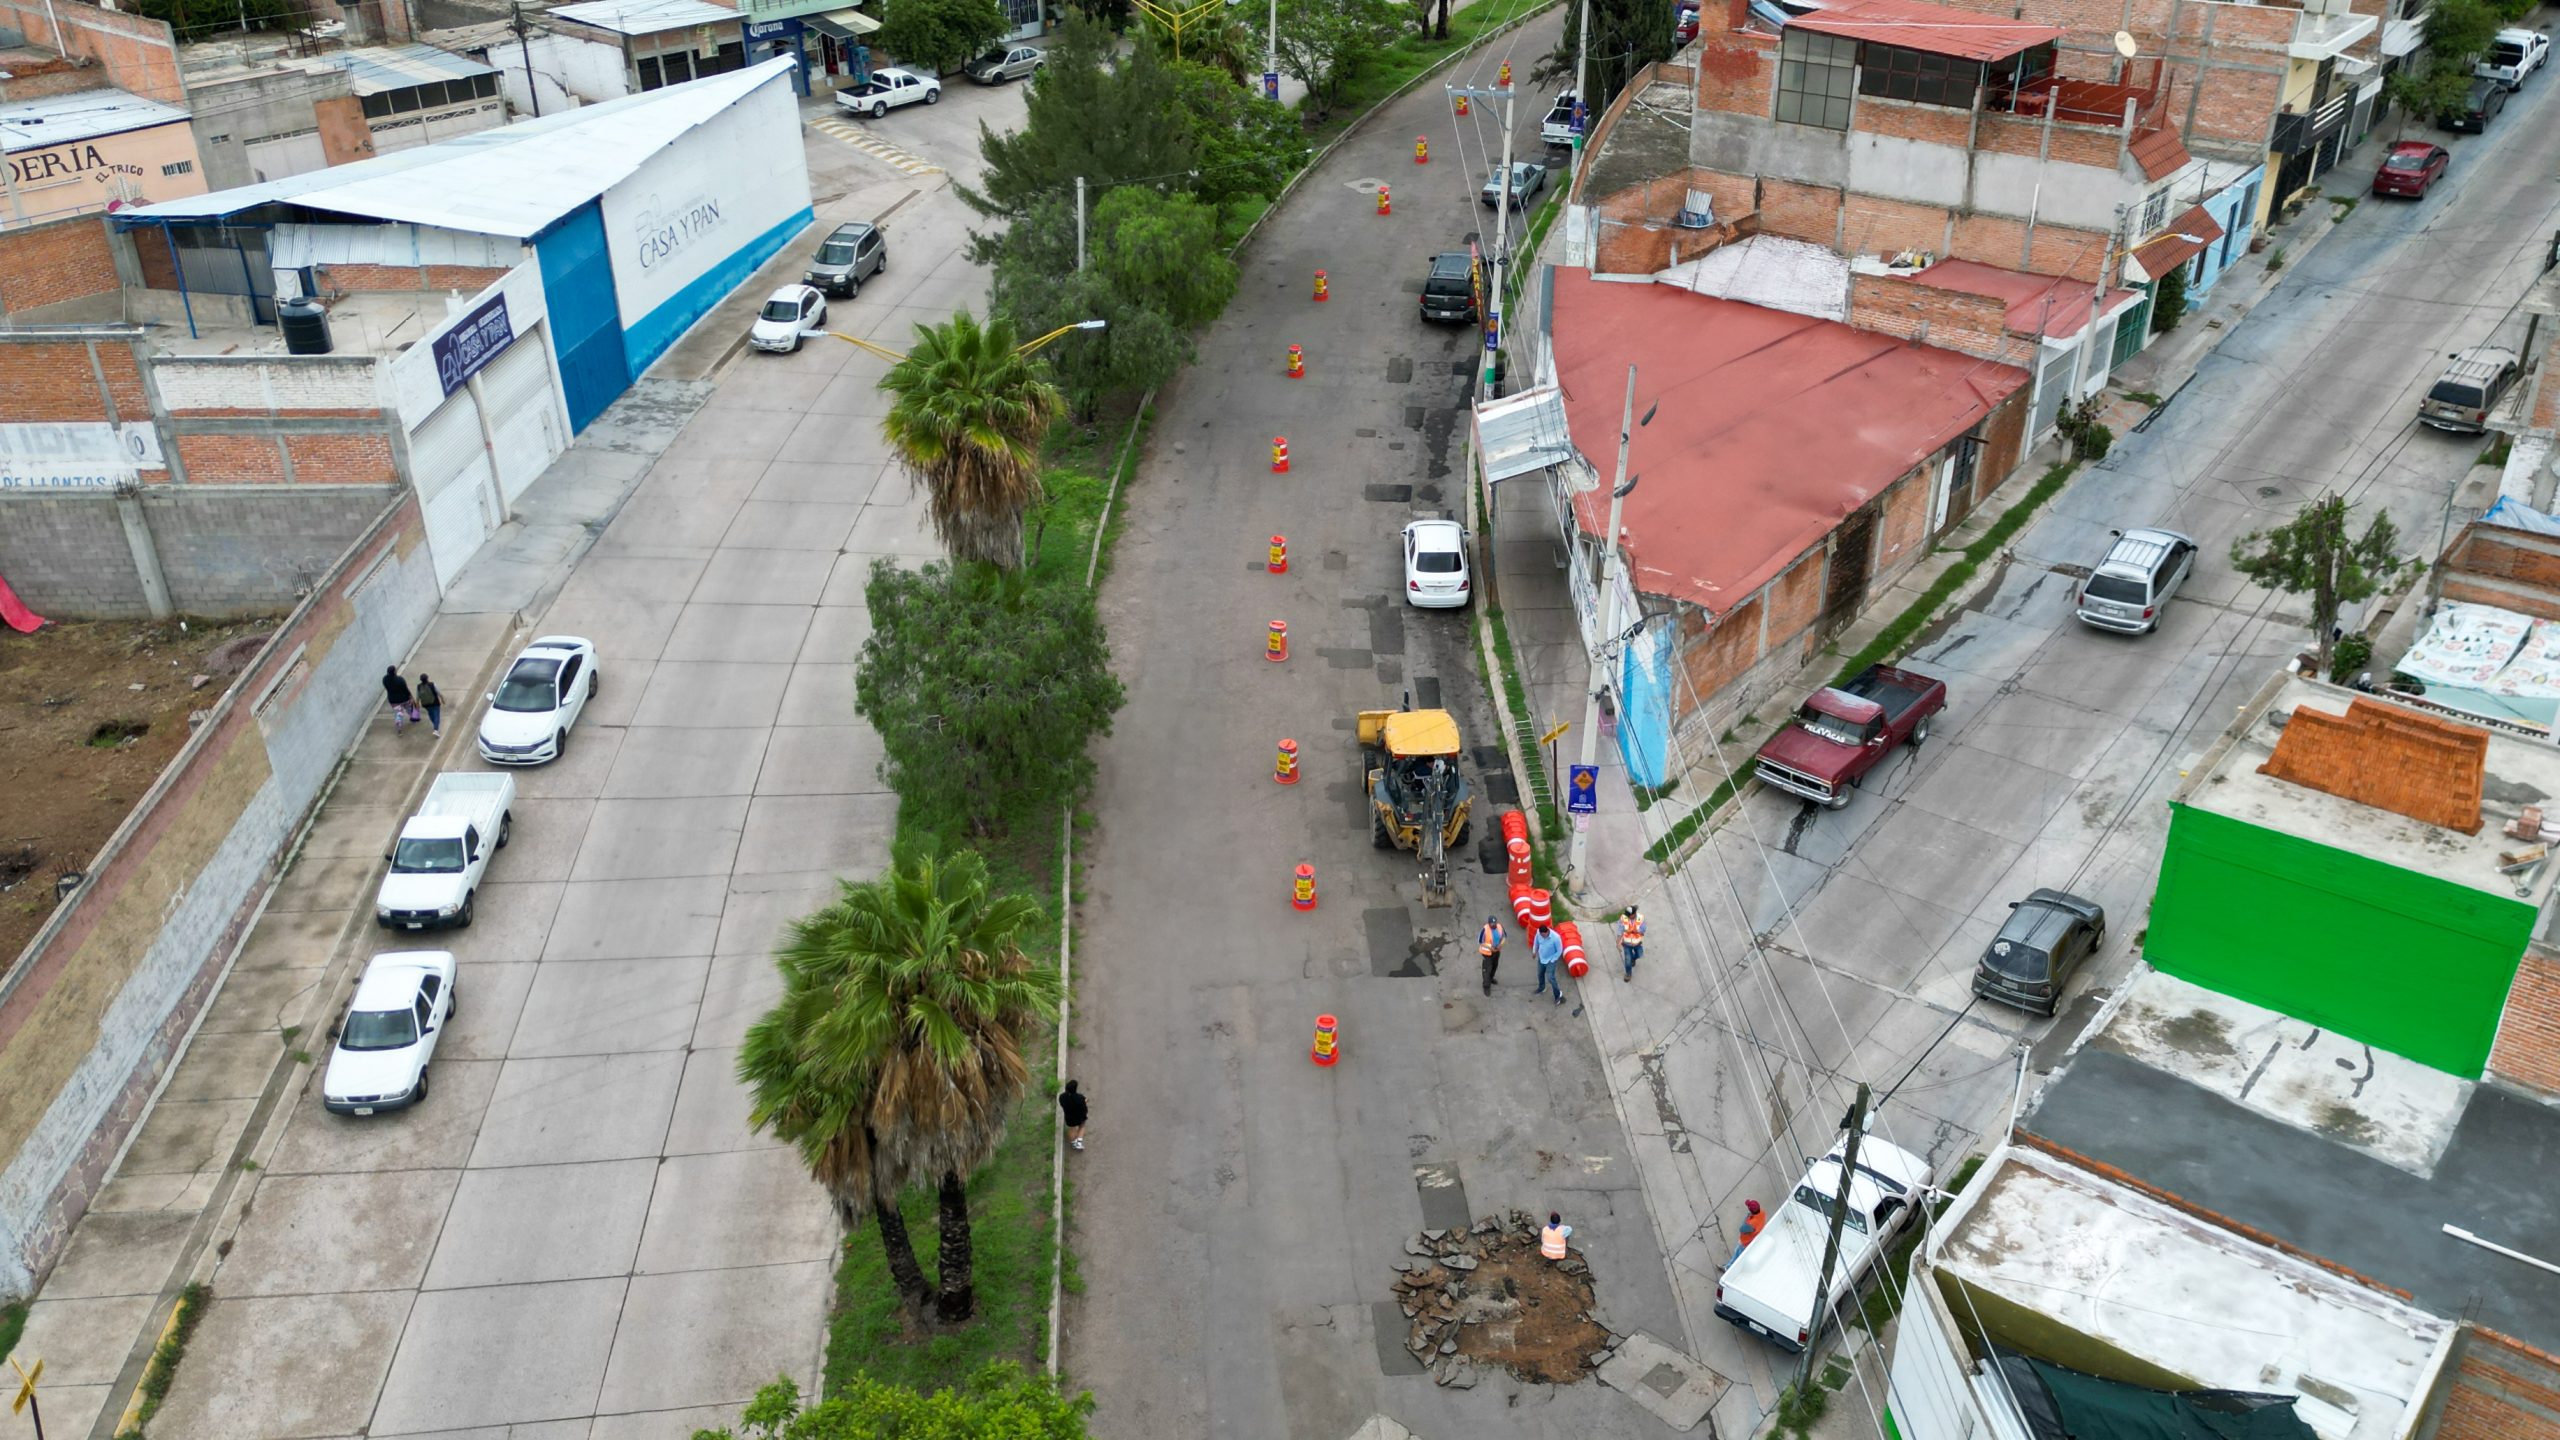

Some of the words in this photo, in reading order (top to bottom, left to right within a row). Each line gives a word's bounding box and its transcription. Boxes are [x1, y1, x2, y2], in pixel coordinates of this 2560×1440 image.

[750, 21, 784, 38] Corona
[640, 225, 679, 268] CASA
[679, 216, 689, 239] Y
[691, 198, 720, 232] PAN
